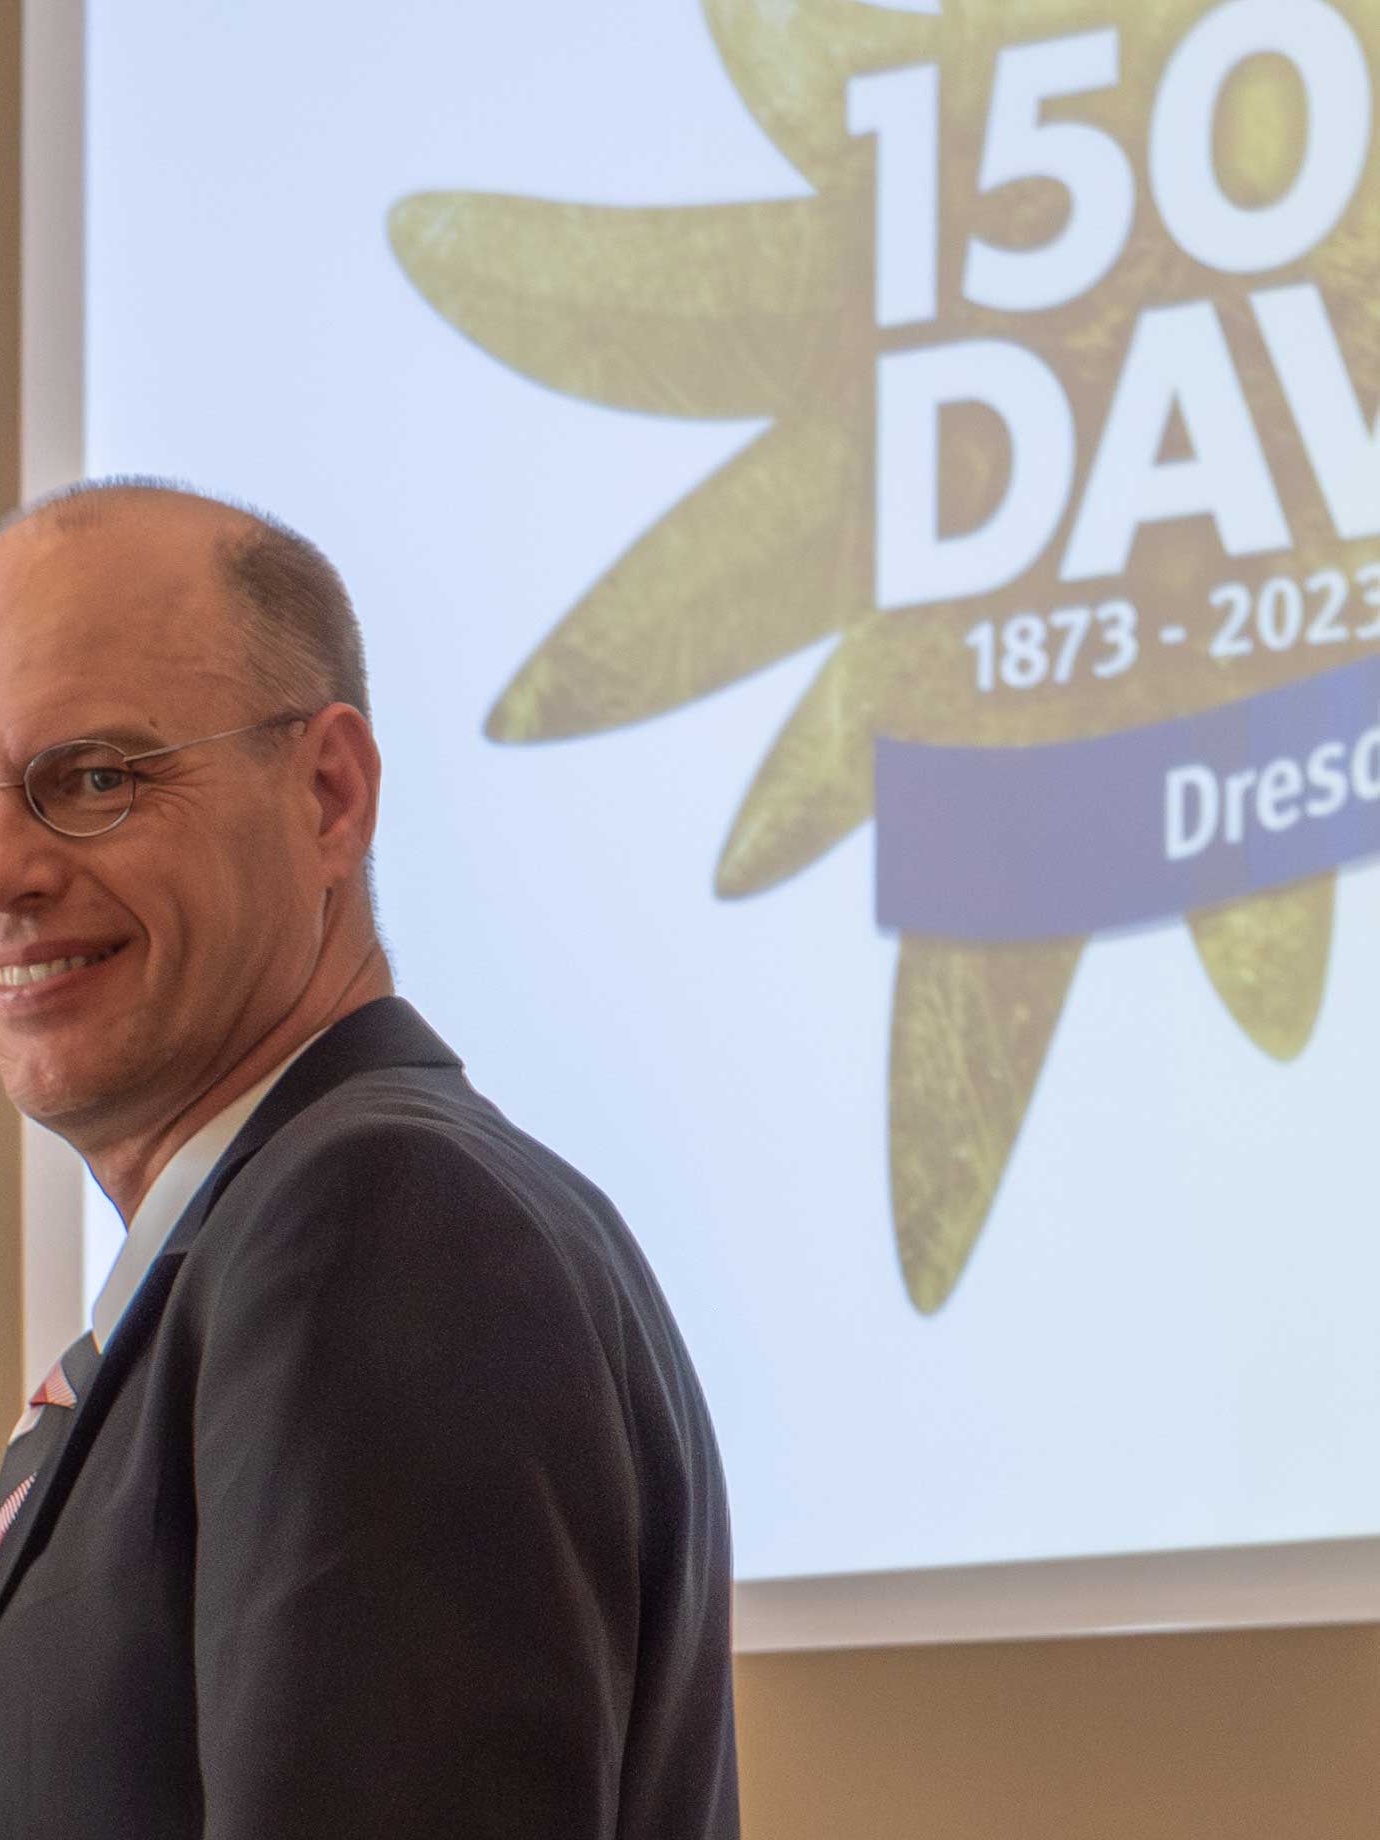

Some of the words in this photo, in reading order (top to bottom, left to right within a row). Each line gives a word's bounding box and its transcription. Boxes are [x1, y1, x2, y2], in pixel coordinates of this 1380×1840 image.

[845, 0, 1371, 328] 150
[875, 282, 1380, 611] DAV
[966, 599, 1139, 694] 1873
[1158, 624, 1187, 646] -
[1208, 562, 1380, 658] 2023
